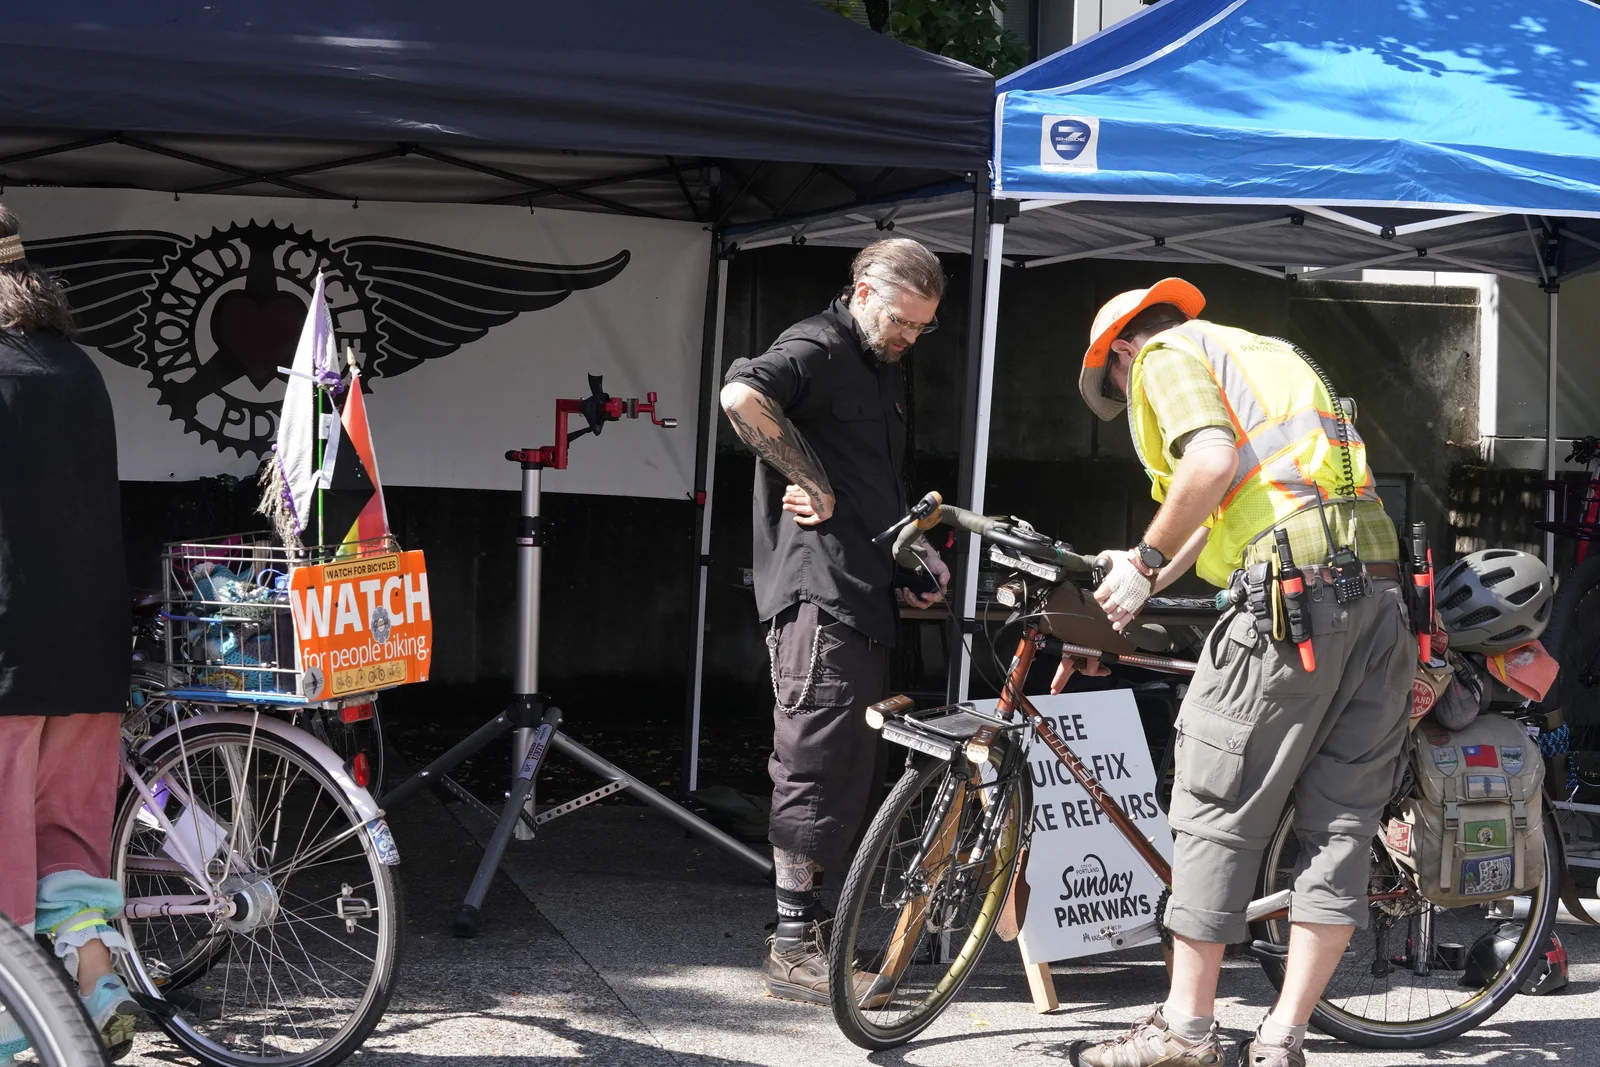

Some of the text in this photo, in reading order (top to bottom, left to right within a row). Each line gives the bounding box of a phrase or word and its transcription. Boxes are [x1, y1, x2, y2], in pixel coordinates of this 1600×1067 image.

[155, 238, 247, 381] NOMAD
[326, 560, 396, 579] WATCH FOR BICYCLES
[291, 572, 431, 641] WATCH
[303, 633, 430, 673] for people biking.
[1034, 713, 1088, 745] REE
[1044, 725, 1111, 802] TREK
[1061, 791, 1159, 829] REPIRS
[1059, 853, 1134, 901] Sunday
[1076, 867, 1100, 875] PORTLAND
[1054, 894, 1151, 928] PARKWAYS
